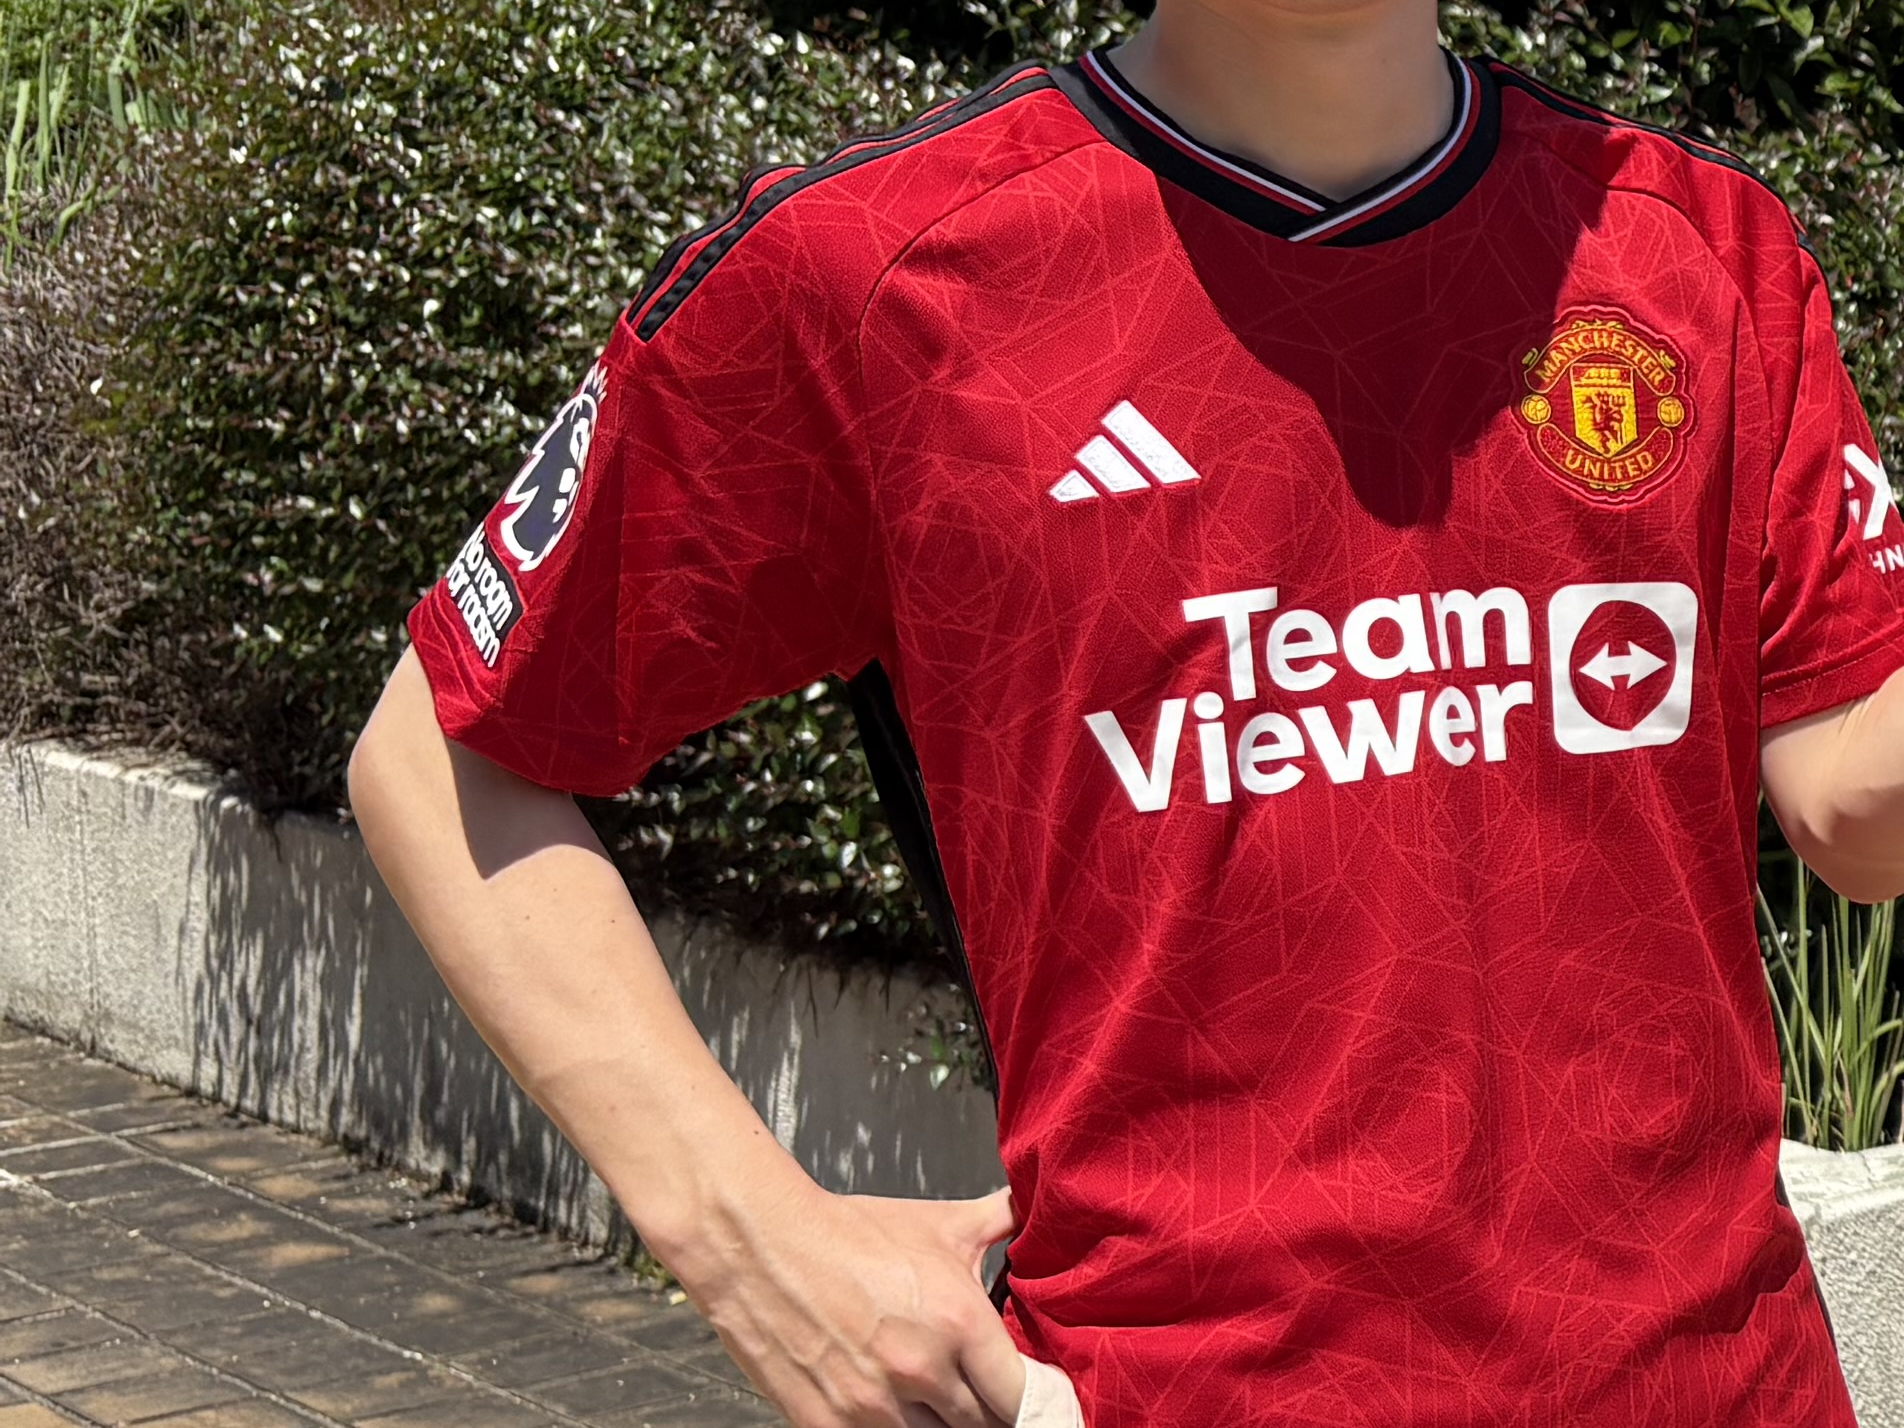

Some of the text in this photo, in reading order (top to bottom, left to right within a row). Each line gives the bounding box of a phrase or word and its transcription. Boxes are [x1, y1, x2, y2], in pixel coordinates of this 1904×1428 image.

[1535, 330, 1666, 386] MANCHESTER
[1564, 449, 1655, 480] UNITED
[474, 562, 513, 631] room
[1182, 585, 1533, 701] Team
[1084, 679, 1533, 813] Viewer
